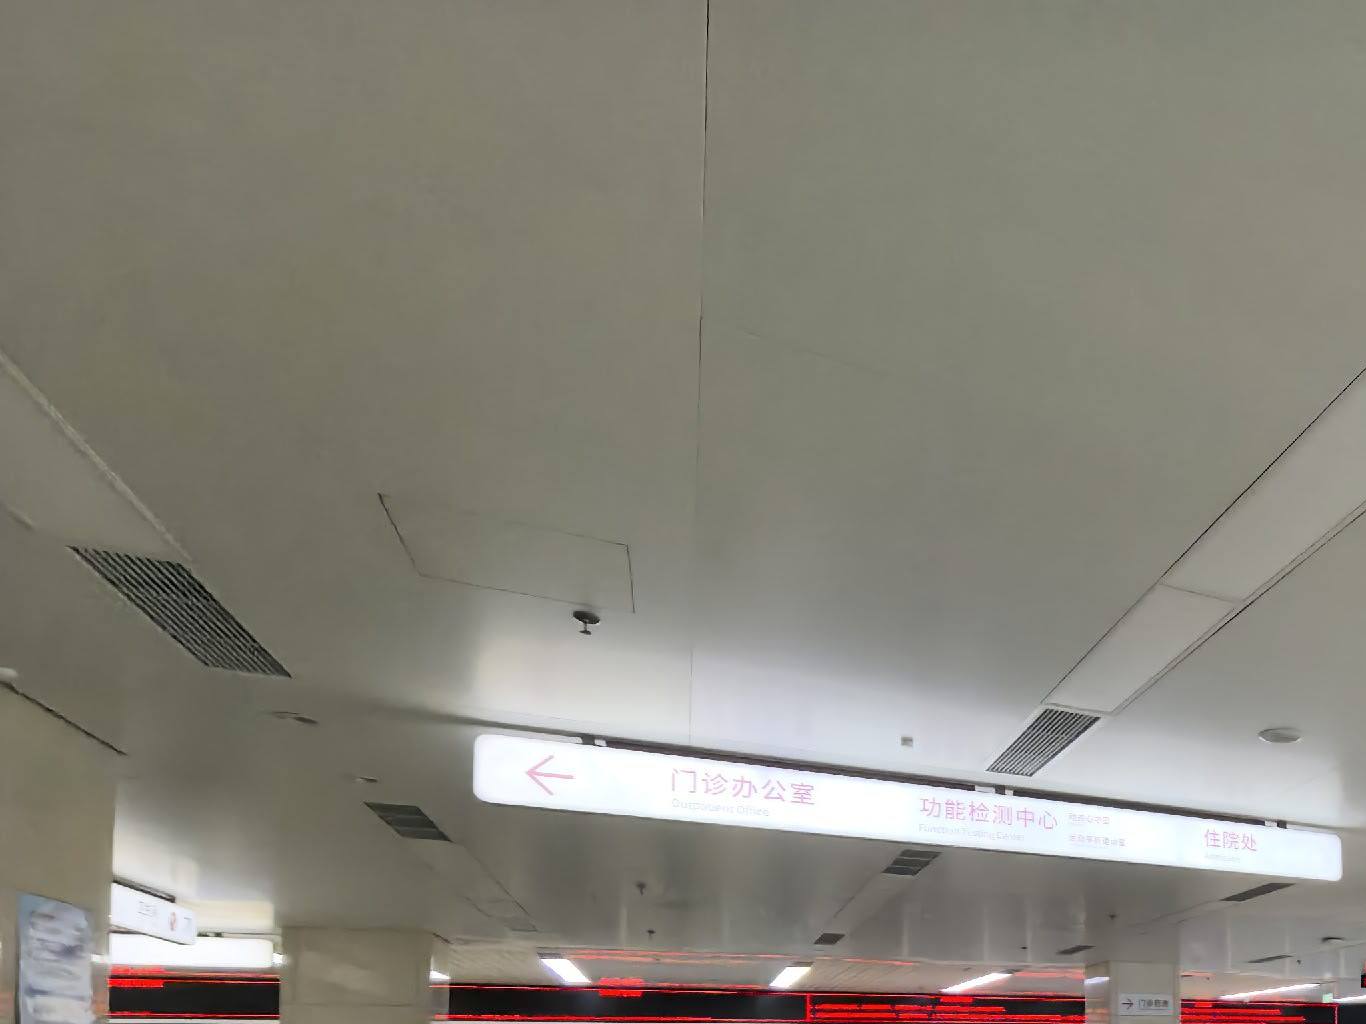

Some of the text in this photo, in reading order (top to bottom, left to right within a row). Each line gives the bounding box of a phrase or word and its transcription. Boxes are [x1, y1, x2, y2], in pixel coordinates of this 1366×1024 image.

[671, 767, 816, 806] 门诊办公室
[919, 797, 1058, 830] 功能检测中心
[1203, 828, 1257, 852] 住院处
